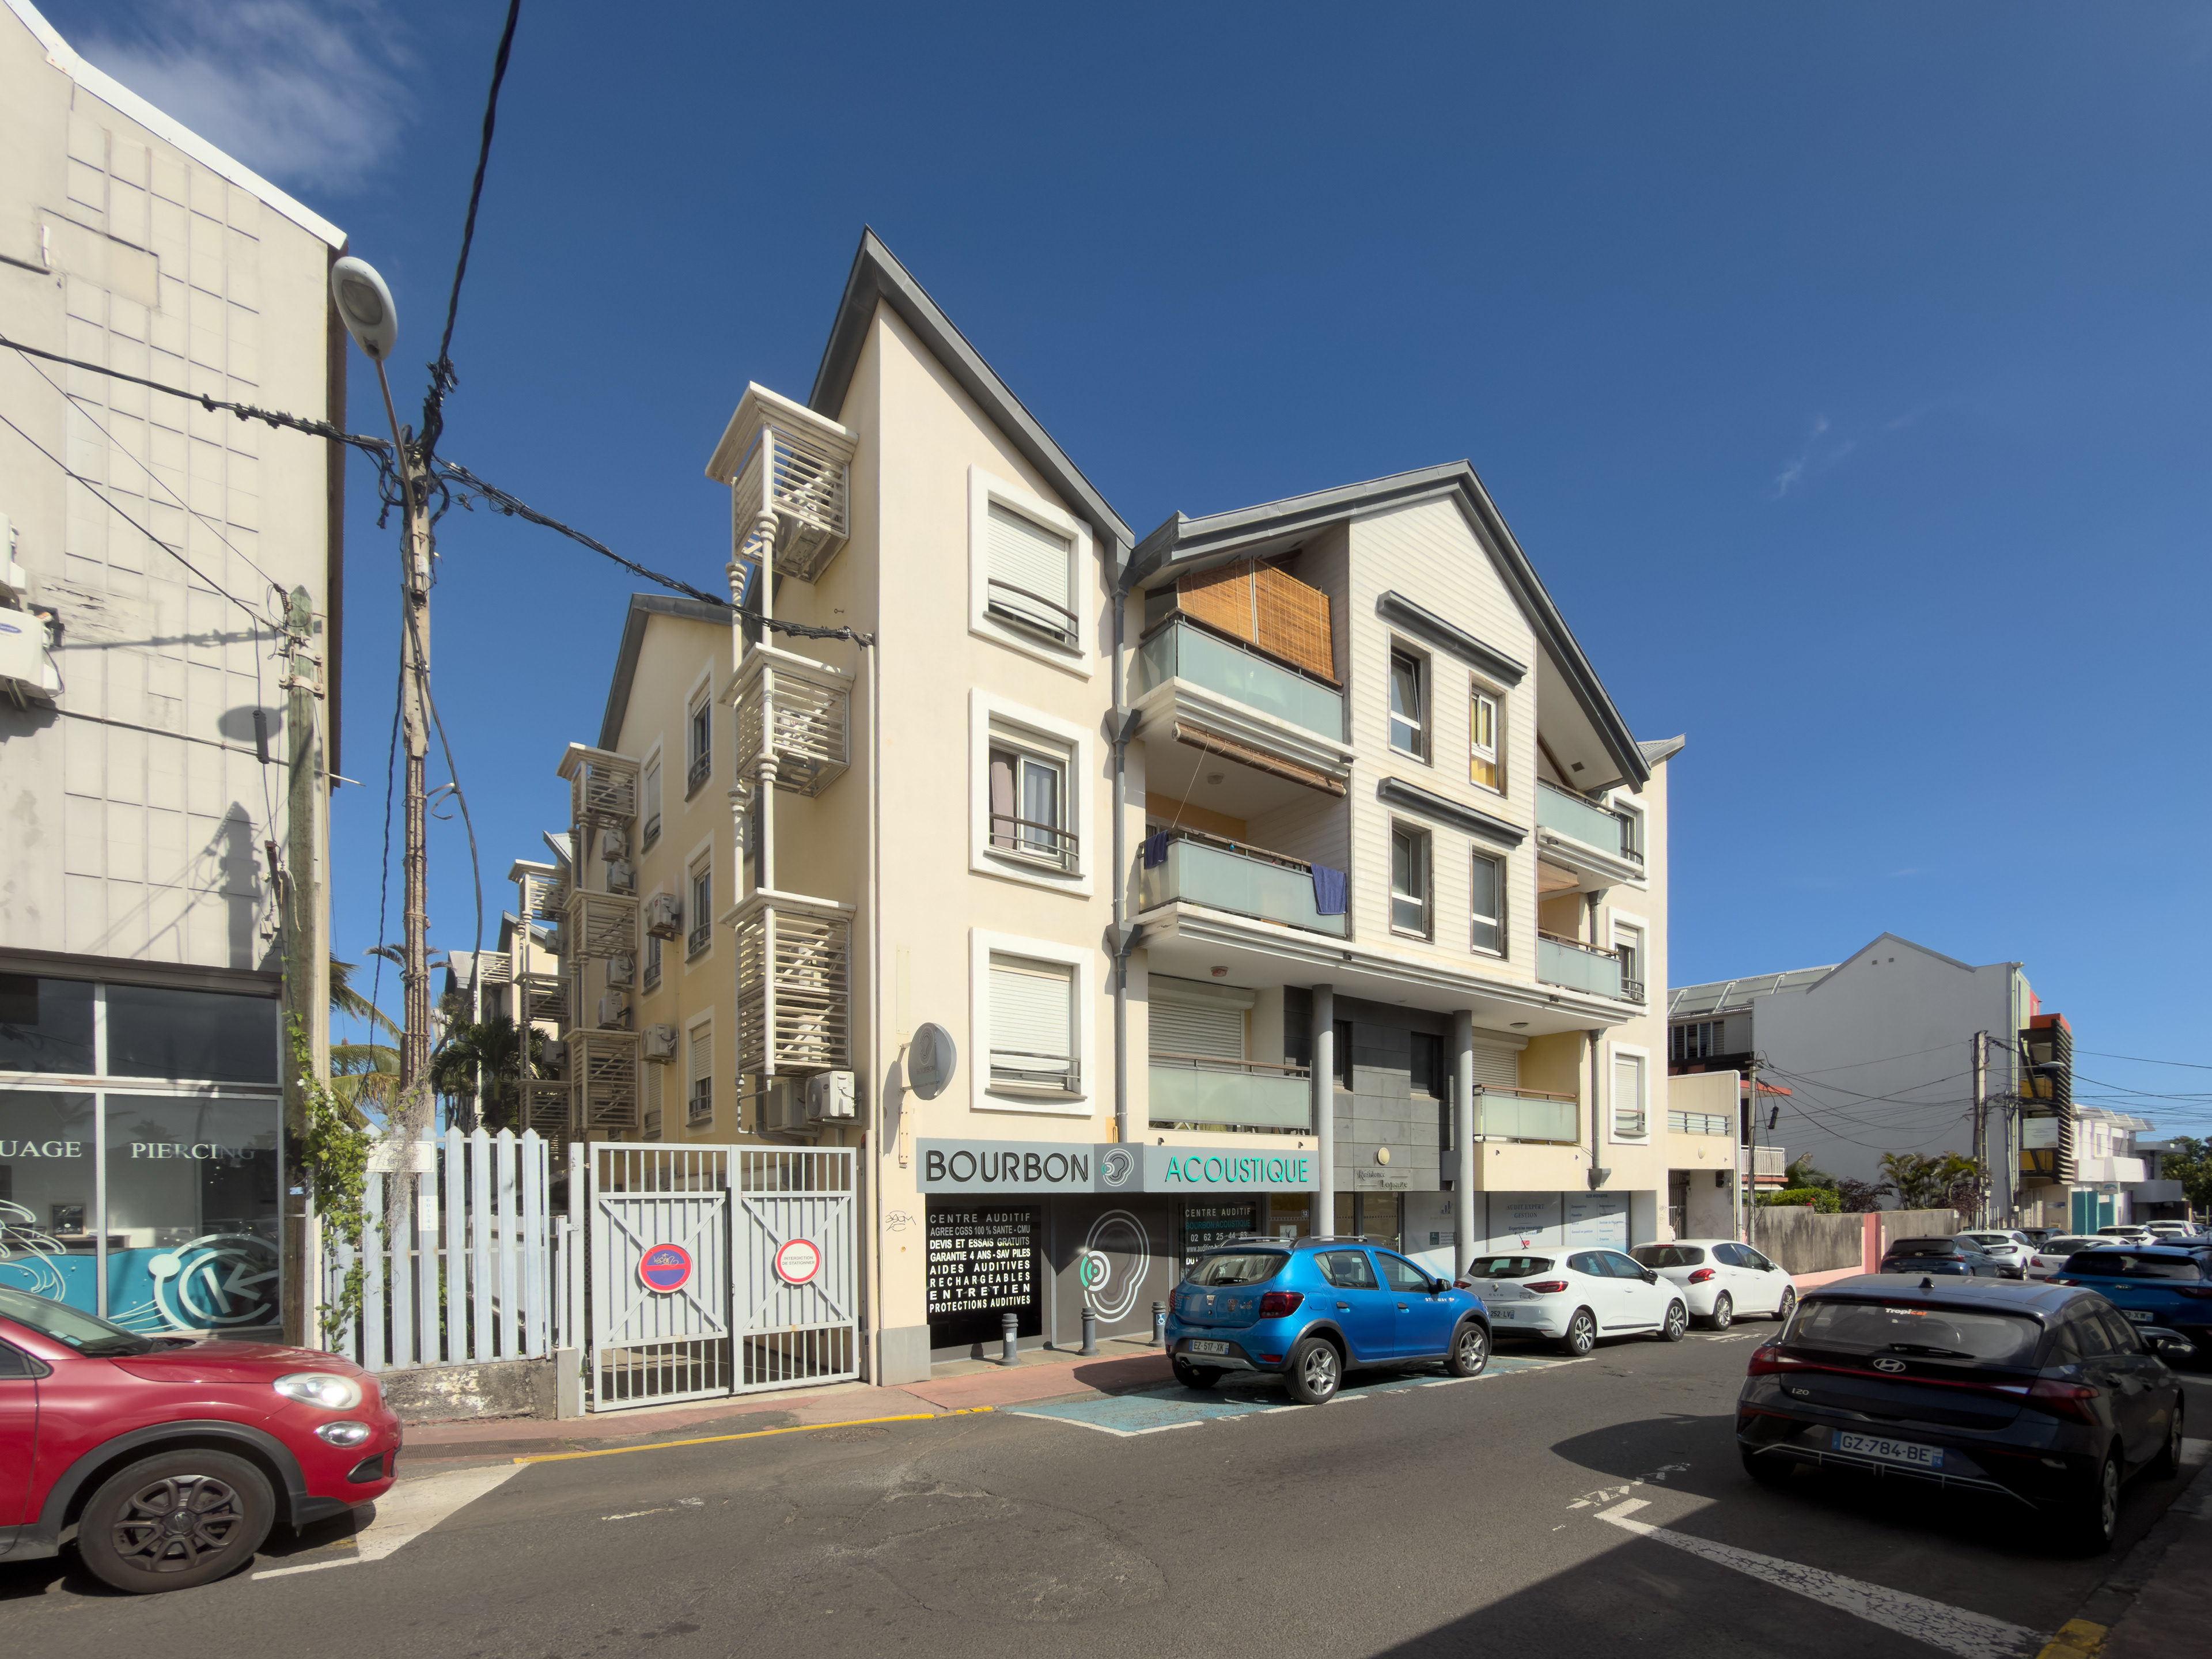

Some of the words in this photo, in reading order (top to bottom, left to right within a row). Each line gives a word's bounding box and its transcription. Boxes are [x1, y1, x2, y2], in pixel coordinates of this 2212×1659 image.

[130, 1142, 255, 1160] PIERCING
[926, 1150, 1088, 1183] BOURBON
[1165, 1156, 1309, 1183] ACOUSTIQUE
[930, 1214, 978, 1223] CENTRE
[986, 1213, 1030, 1222] AUDITIF
[1185, 1209, 1217, 1217] CENTRE
[1221, 1207, 1251, 1217] AUDITIF
[930, 1227, 953, 1236] AGREE
[955, 1226, 973, 1236] CGSS
[974, 1226, 984, 1235] 100
[986, 1226, 991, 1234] %
[993, 1225, 1012, 1234] SANTE
[1017, 1225, 1031, 1234] CMU
[1185, 1221, 1214, 1230] BOURBON
[1215, 1219, 1251, 1228] ACOUSTIQUE
[930, 1239, 952, 1249] DEVIS
[956, 1239, 965, 1248] ET
[968, 1238, 994, 1248] ESSAIS
[997, 1237, 1029, 1246] GRATUITS
[1191, 1234, 1198, 1242] 02
[930, 1251, 967, 1262] GARANTIE
[969, 1251, 974, 1260] 4
[1012, 1248, 1031, 1257] PILES
[930, 1264, 964, 1275] AIDES
[974, 1260, 1030, 1272] AUDITIVES
[1186, 1257, 1195, 1266] DU
[930, 1272, 1030, 1287] RECHARGEABLES
[930, 1283, 1030, 1300] ENTRETIEN
[930, 1299, 987, 1313] PROTECTIONS
[990, 1295, 1031, 1308] AUDITIVES
[1885, 1308, 1927, 1316] Tropicar
[1194, 1341, 1224, 1352] EZ-517-XK
[1842, 1435, 1930, 1463] GZ-784-BE
